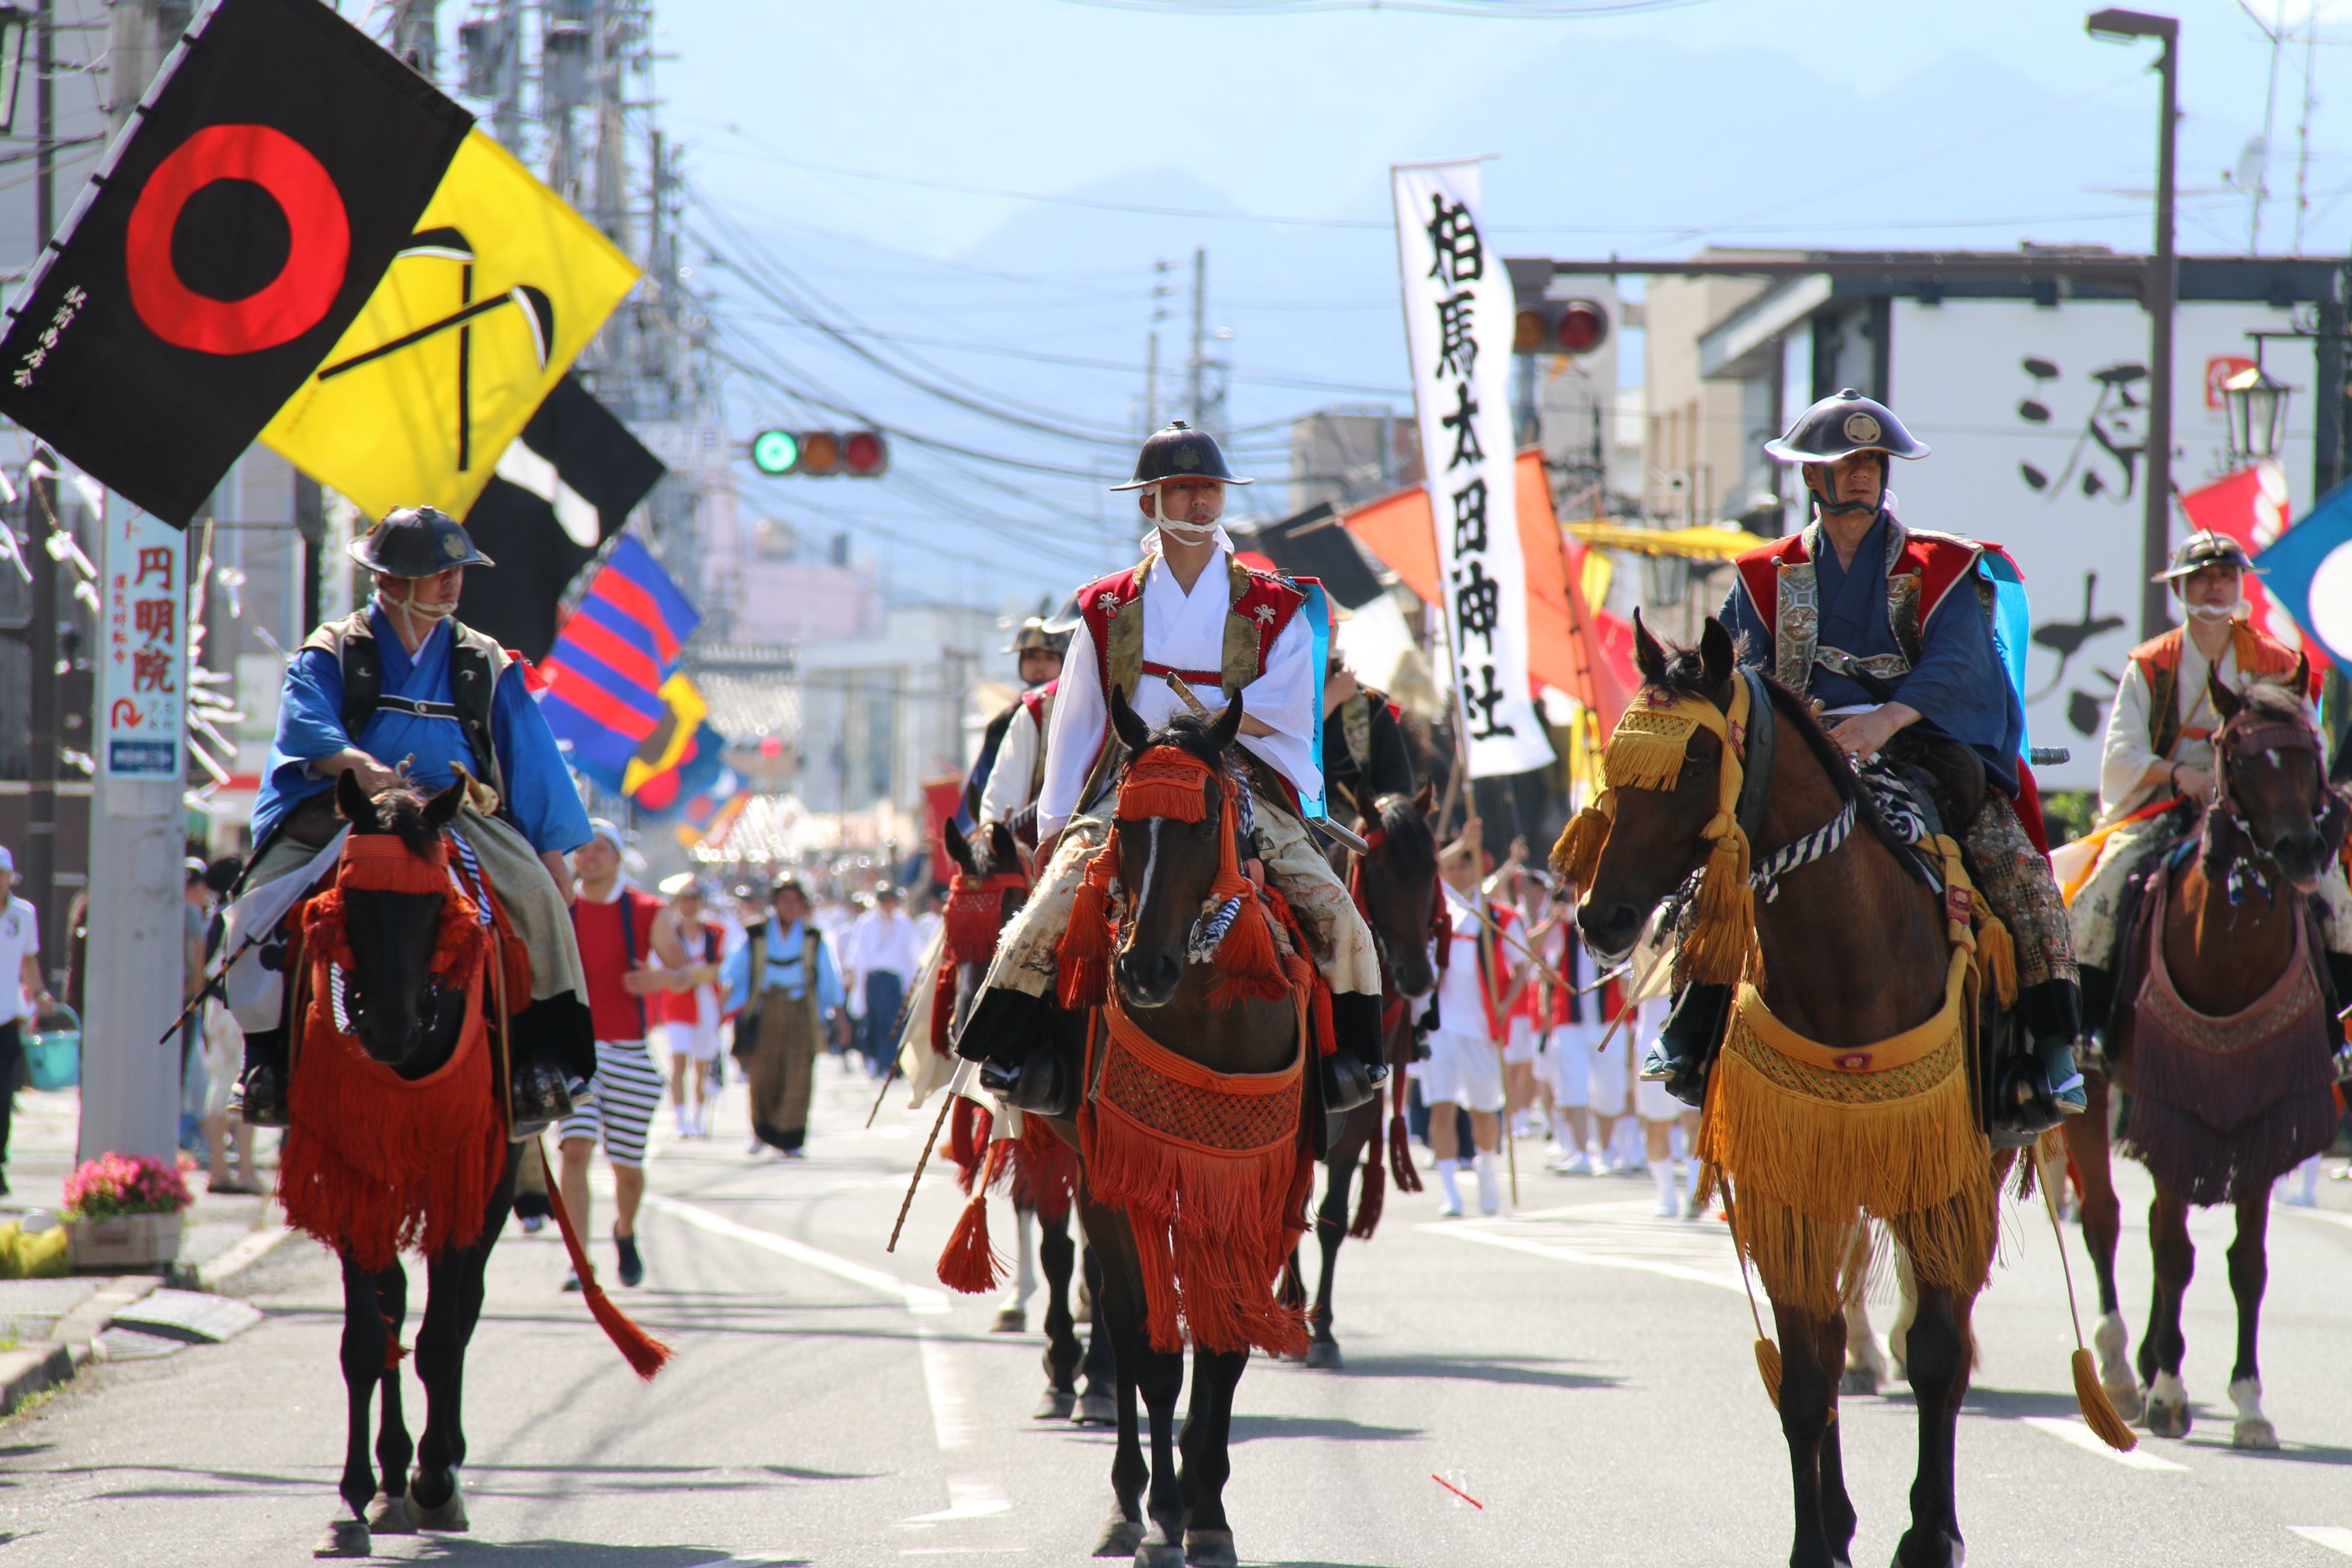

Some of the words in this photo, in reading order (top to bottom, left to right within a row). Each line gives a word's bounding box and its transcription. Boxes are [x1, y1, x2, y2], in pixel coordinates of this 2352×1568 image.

[133, 547, 175, 693] 円明院
[1426, 191, 1516, 741] 相馬太田神社
